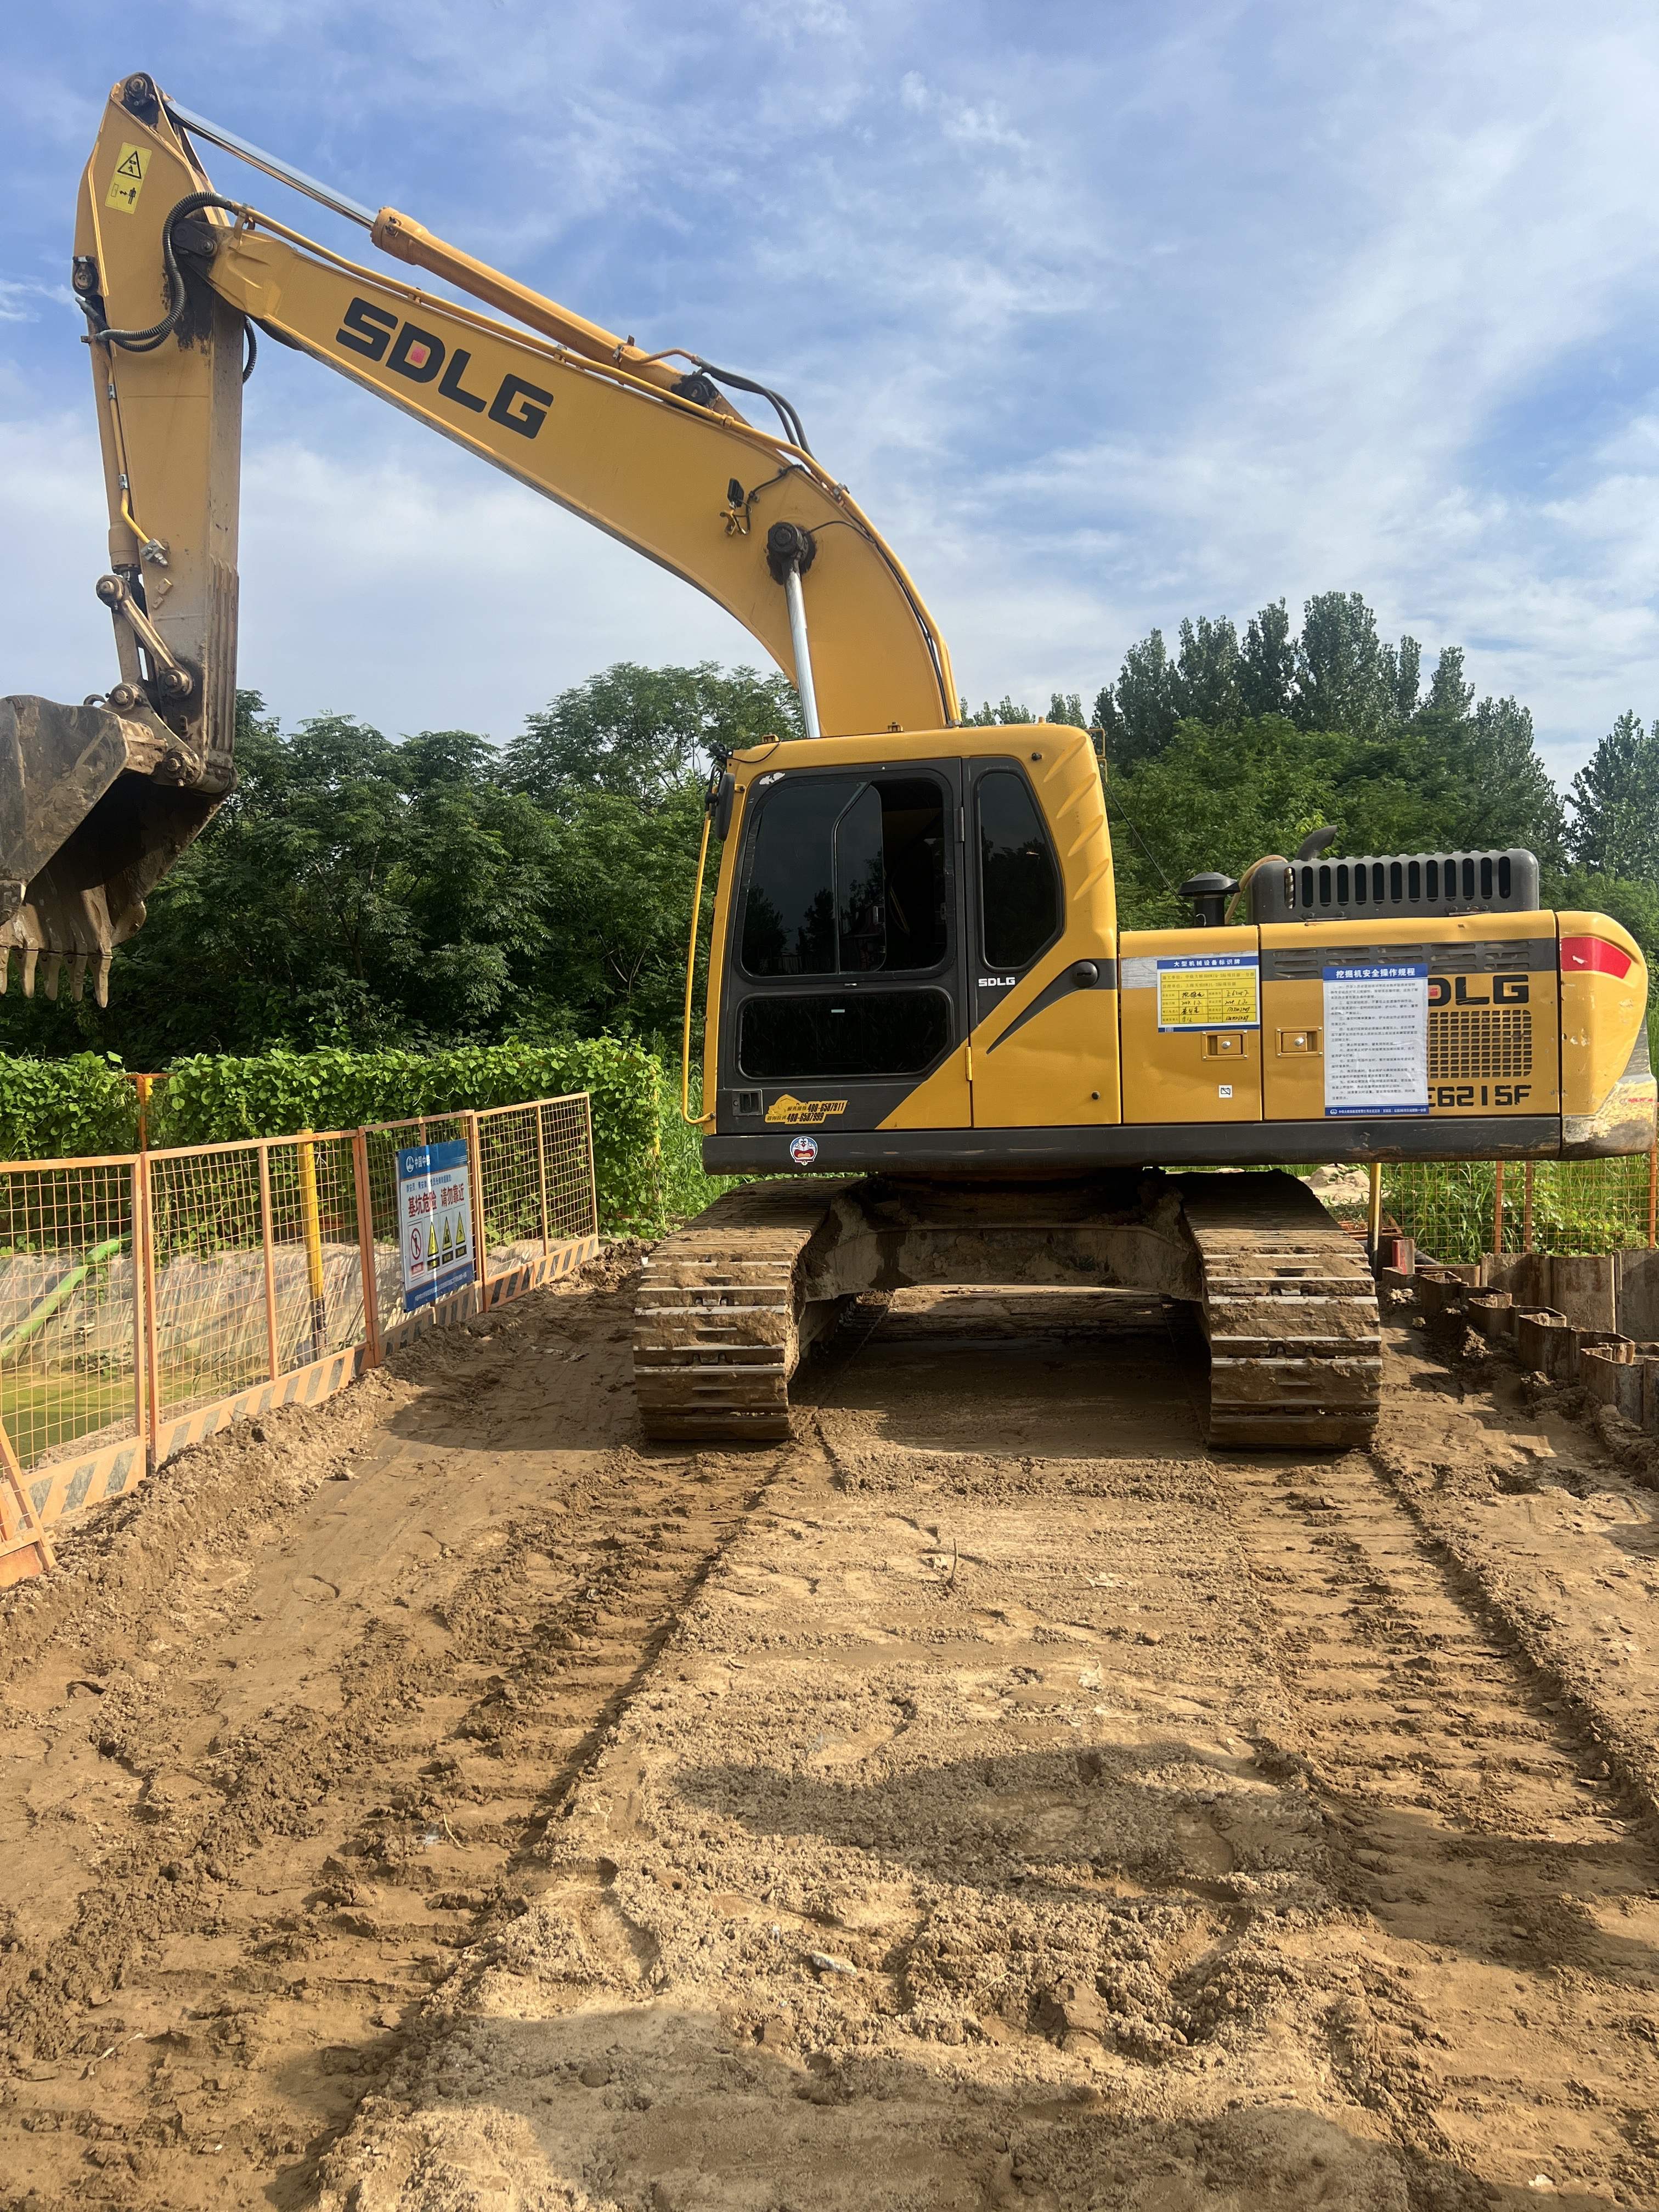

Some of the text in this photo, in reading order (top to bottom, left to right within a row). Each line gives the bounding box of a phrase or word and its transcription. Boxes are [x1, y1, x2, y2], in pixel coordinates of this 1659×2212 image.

[336, 297, 554, 439] SDLG
[1173, 958, 1240, 967] 大型机械设备标识牌
[1336, 968, 1415, 979] 挖掘机安全操作规程
[978, 977, 1015, 987] SDLG
[1428, 974, 1529, 1006] DLG
[808, 1102, 845, 1112] 400-6587911
[787, 1112, 824, 1122] 400-6587999
[408, 1183, 464, 1218] 基坑危险 请勿靠近
